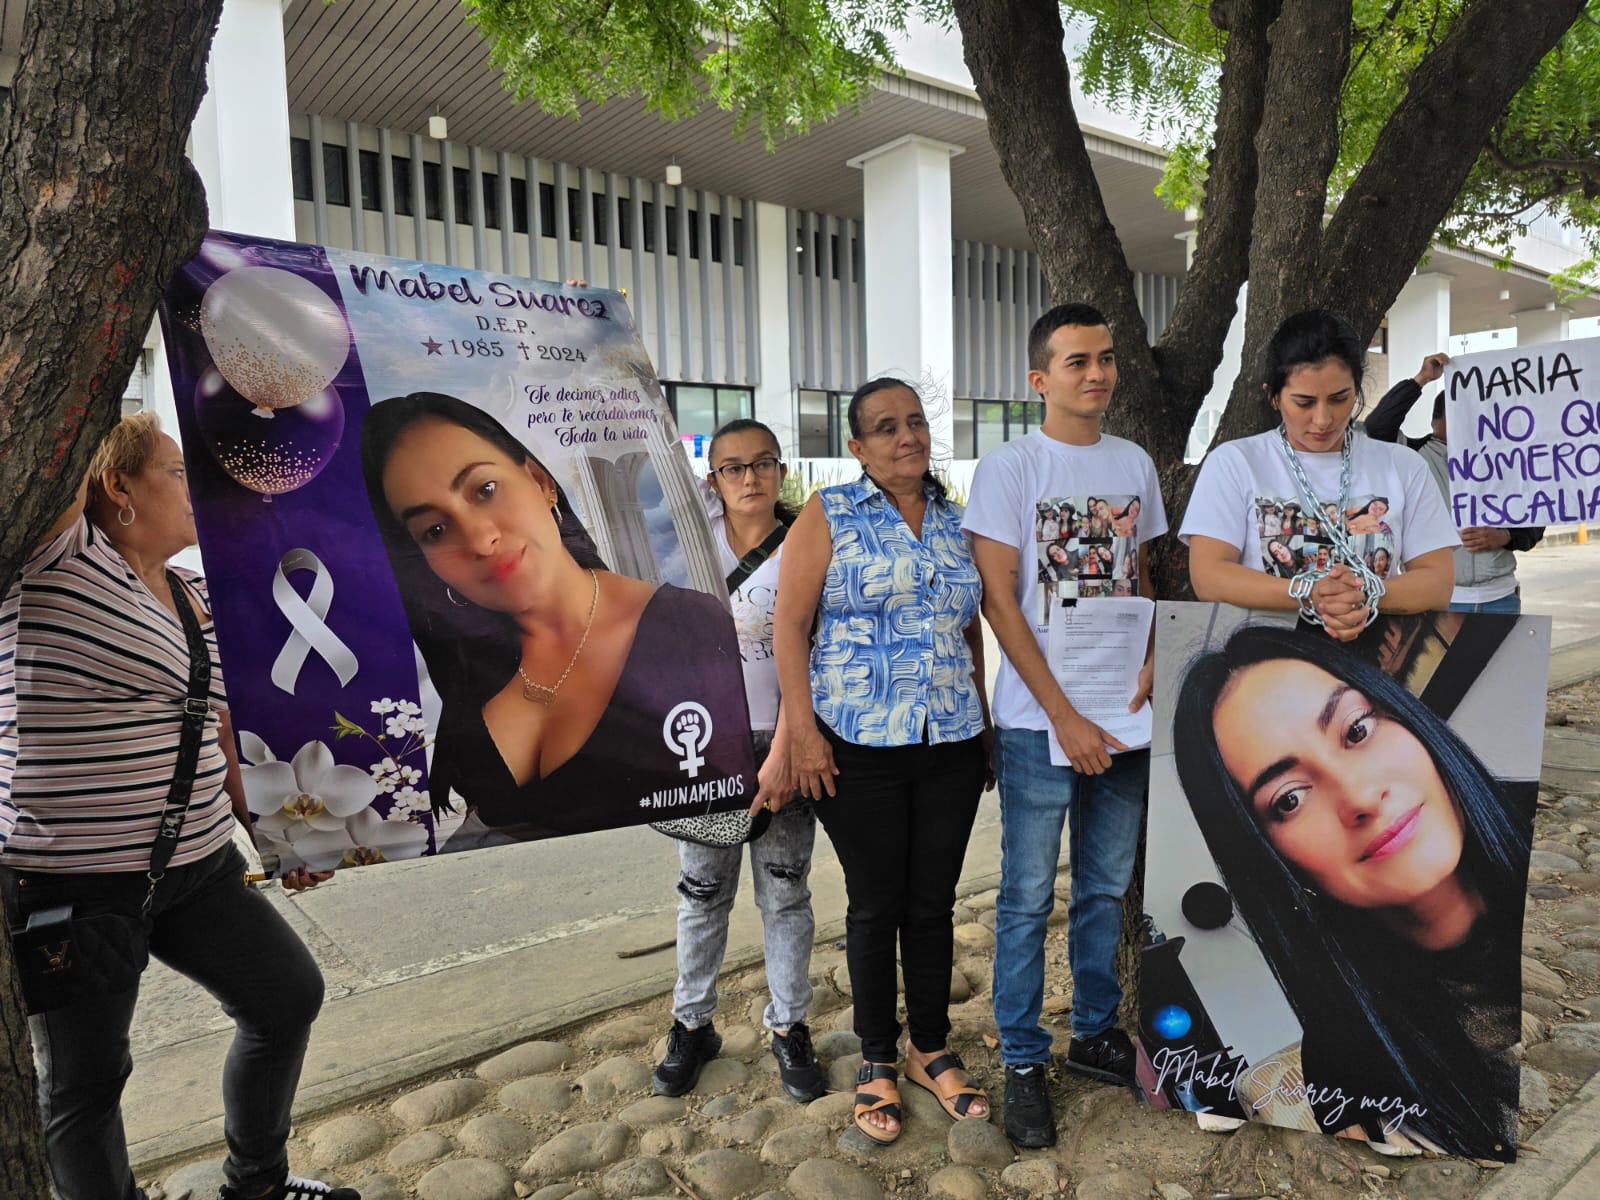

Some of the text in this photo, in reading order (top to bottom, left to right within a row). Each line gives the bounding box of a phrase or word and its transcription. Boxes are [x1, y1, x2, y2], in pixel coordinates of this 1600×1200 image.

[349, 264, 611, 320] Mabel Suarez
[475, 315, 536, 335] D.E.P.
[449, 338, 588, 363] 1985 2024
[1450, 352, 1583, 401] MARIA
[524, 384, 640, 404] Te decimos adios
[527, 406, 658, 428] pero te recordaremos
[1478, 399, 1600, 442] NO Q
[554, 425, 649, 447] Toda la vida
[639, 774, 744, 809] #NIUNAMENOS
[1152, 1044, 1246, 1101] Mabel
[1359, 1094, 1428, 1136] meza
